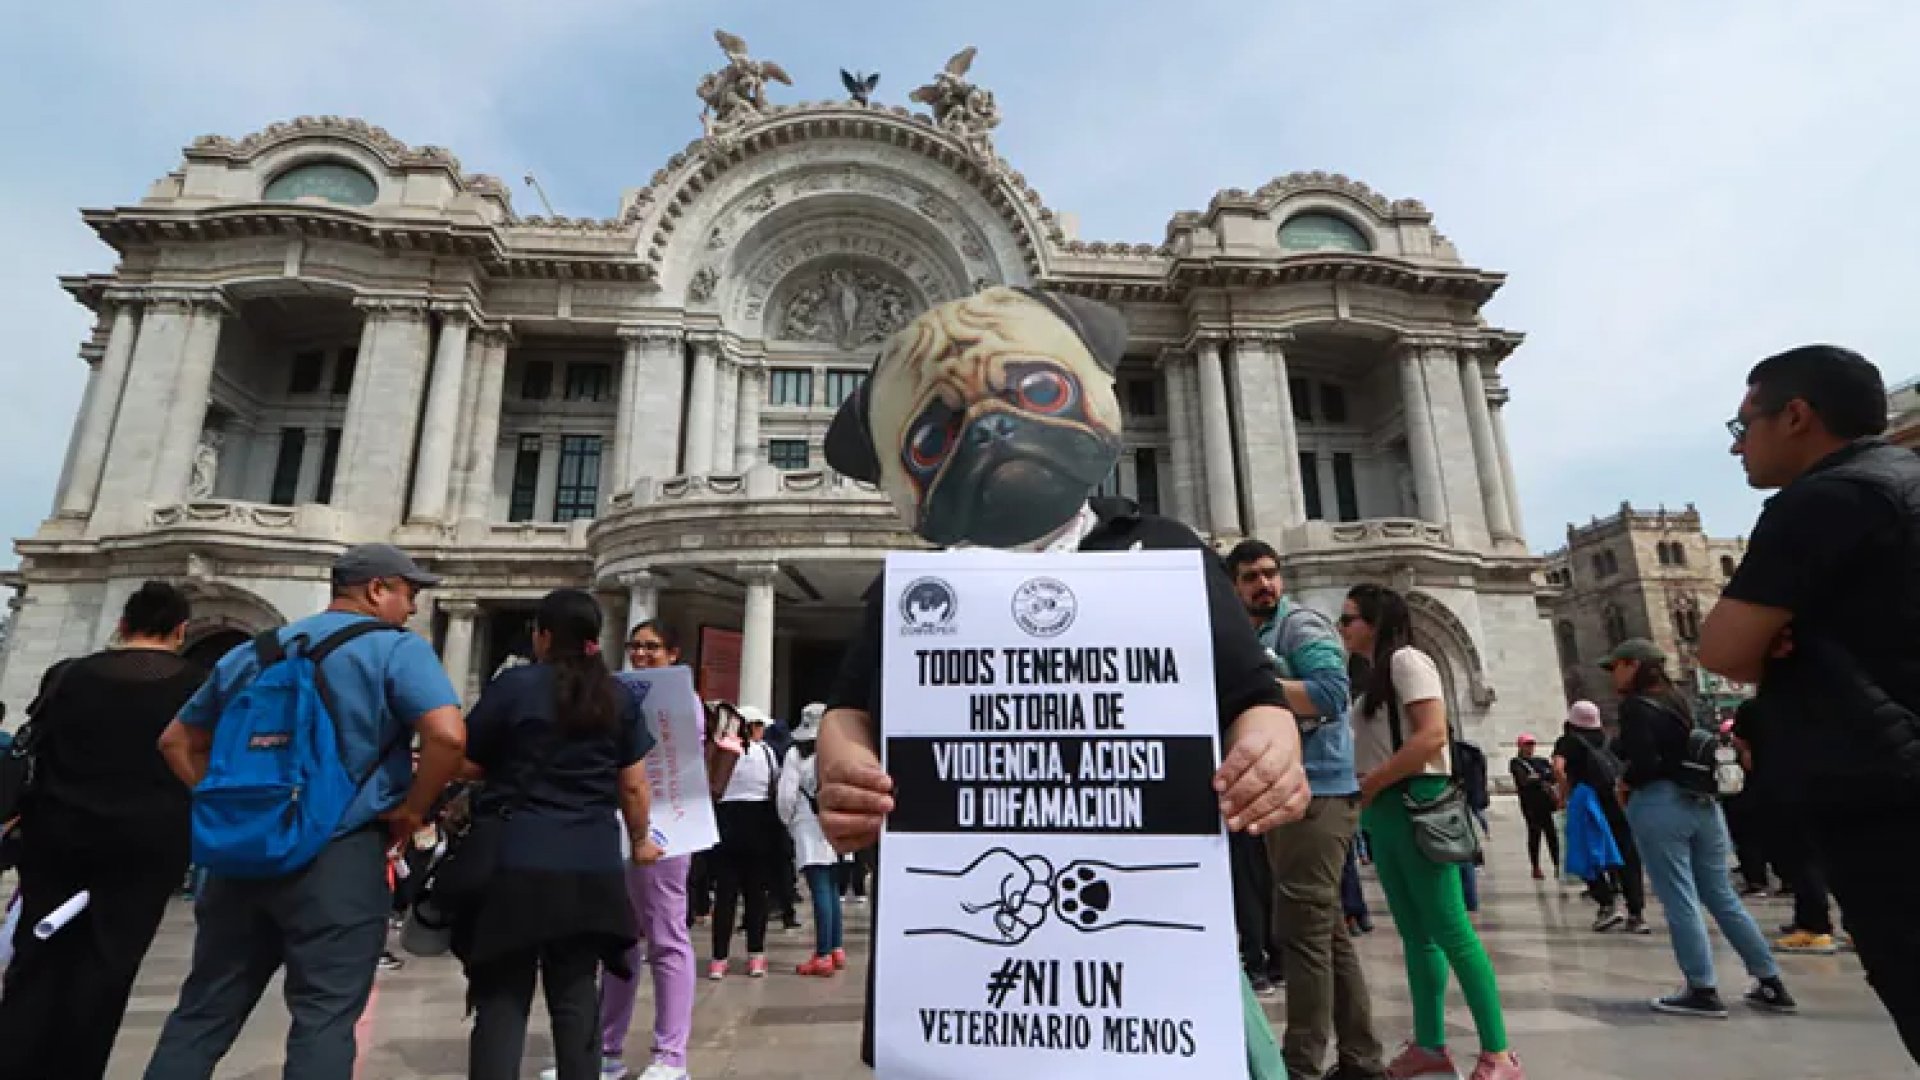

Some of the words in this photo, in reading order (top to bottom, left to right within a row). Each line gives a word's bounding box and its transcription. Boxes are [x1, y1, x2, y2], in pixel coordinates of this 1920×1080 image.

[915, 649, 995, 686] TODOS
[1003, 648, 1119, 684] TENEMOS
[1126, 648, 1179, 683] UNA
[970, 694, 1085, 731] HISTORIA
[1093, 693, 1125, 729] DE
[932, 741, 1070, 783] VIOLENCIA,
[1079, 740, 1165, 781] ACOSO
[958, 787, 975, 827] O
[982, 780, 1143, 828] DIFAMACIÓN
[986, 957, 1060, 1008] #NI
[1074, 961, 1124, 1008] UN
[919, 1008, 1091, 1049] VETERINARIO
[1102, 1016, 1197, 1057] MENOS
